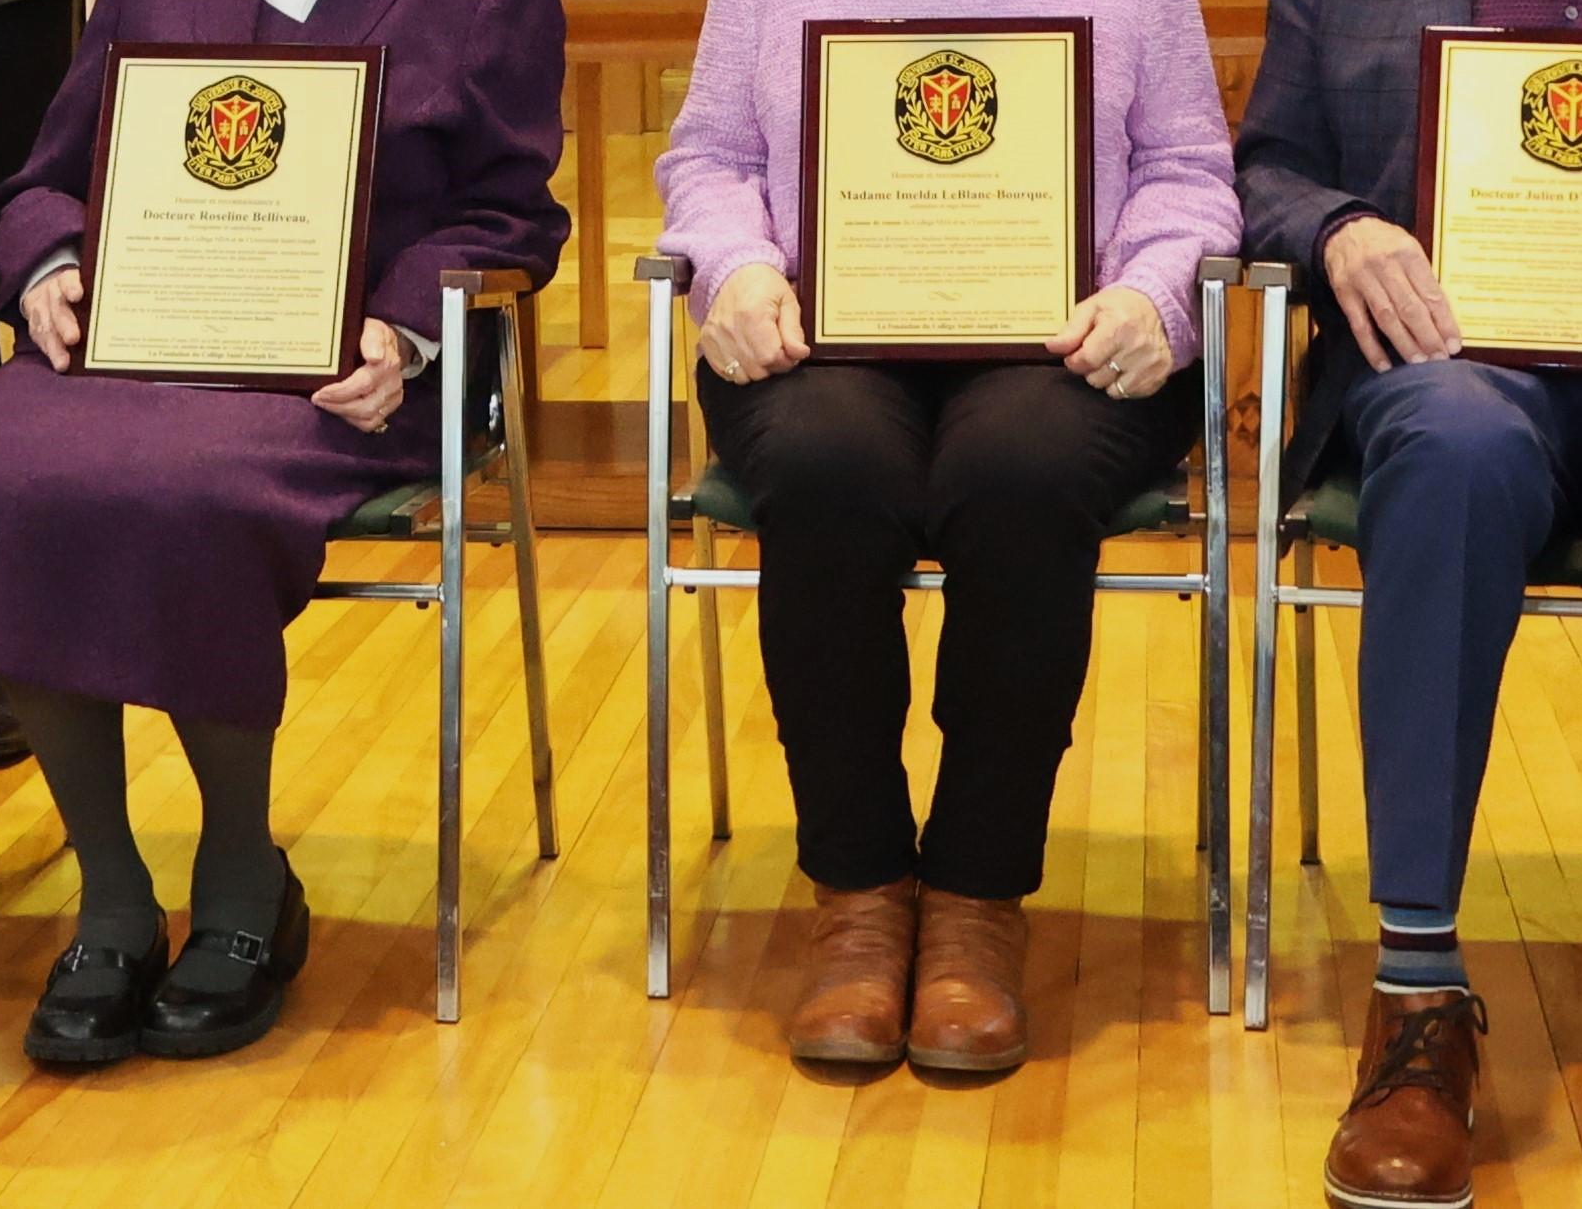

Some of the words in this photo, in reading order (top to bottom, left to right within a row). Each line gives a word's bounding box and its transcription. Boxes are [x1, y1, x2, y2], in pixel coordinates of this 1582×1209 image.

[839, 190, 892, 201] Madame
[896, 189, 938, 201] Imelda
[1470, 188, 1524, 200] Docteur
[1525, 189, 1564, 202] Julien
[200, 210, 249, 222] Roseline
[252, 211, 311, 225] Belliveau,
